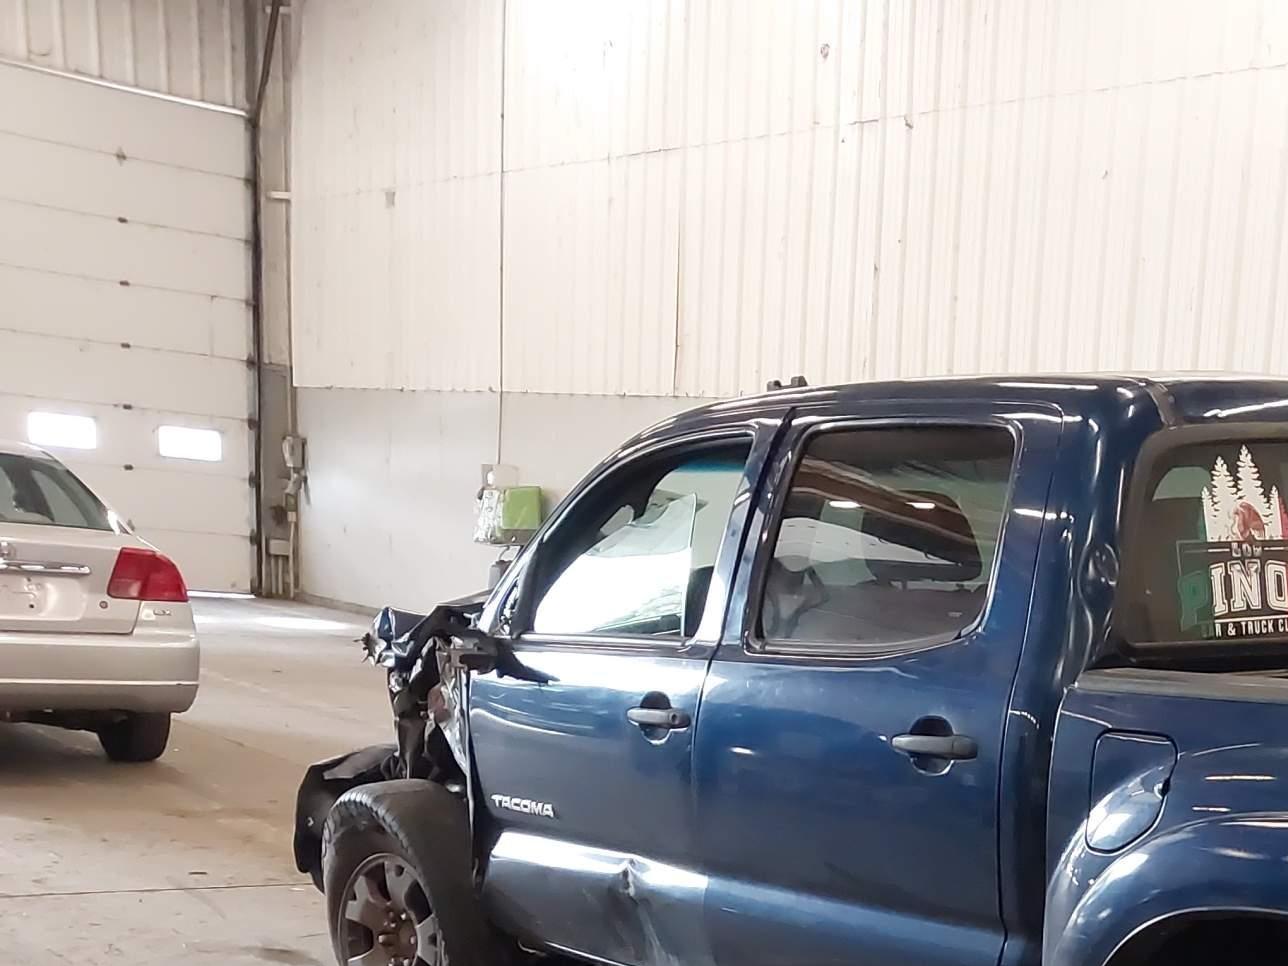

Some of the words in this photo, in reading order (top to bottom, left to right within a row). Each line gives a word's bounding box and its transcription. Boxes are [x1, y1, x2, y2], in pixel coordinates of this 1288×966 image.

[1227, 622, 1237, 636] &
[1240, 619, 1274, 636] TRUCK
[491, 794, 555, 818] TACOMA
